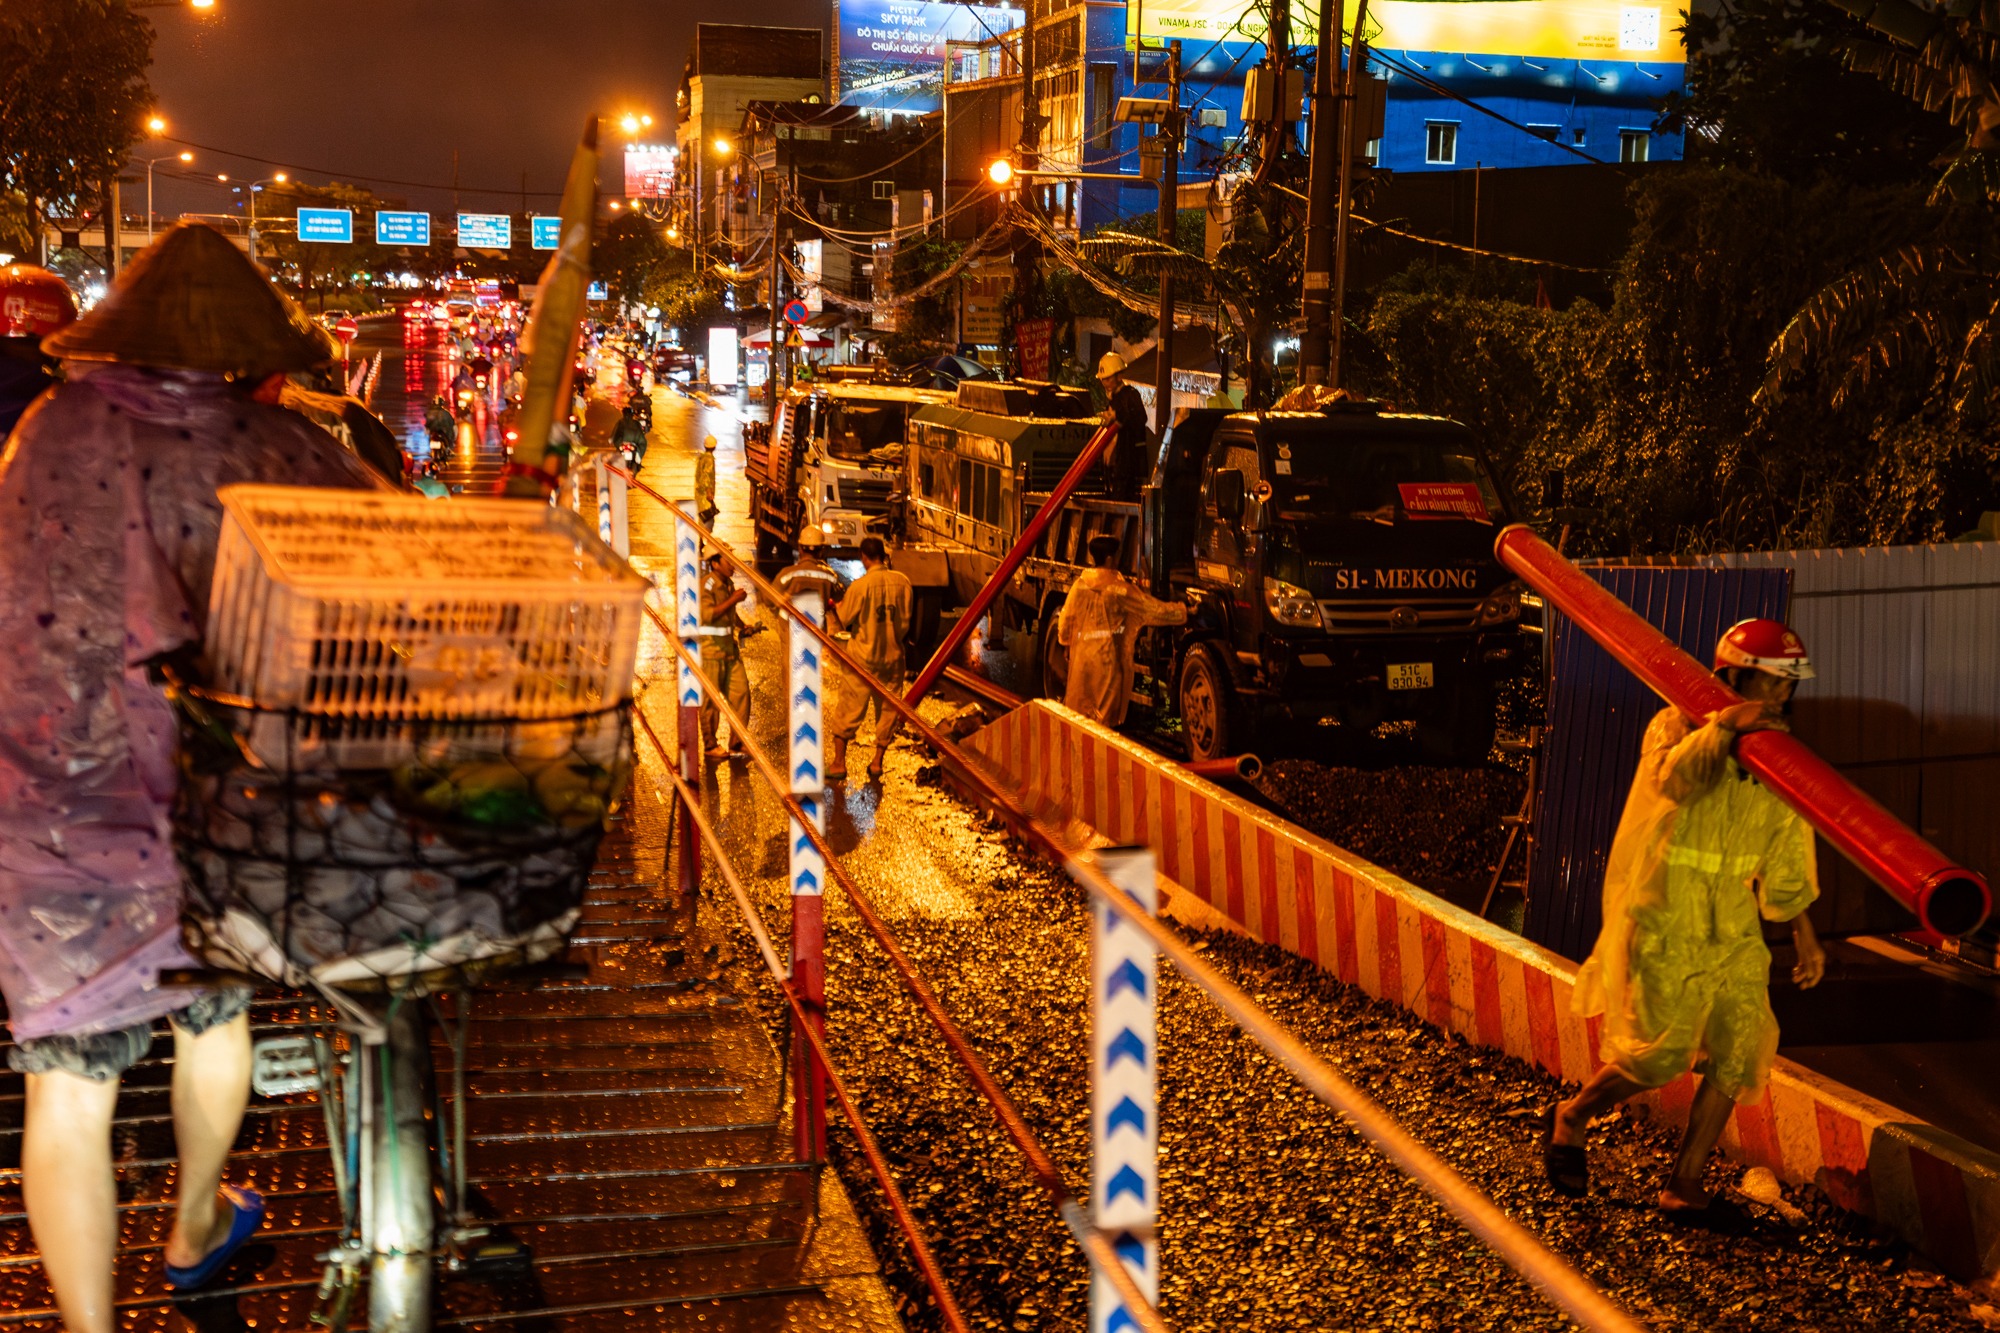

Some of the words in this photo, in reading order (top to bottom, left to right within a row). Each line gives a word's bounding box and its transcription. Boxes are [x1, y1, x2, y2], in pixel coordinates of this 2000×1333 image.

[889, 5, 918, 14] PICITY
[881, 14, 900, 25] SKY
[901, 15, 927, 27] PARK
[1158, 17, 1190, 28] VINAMA
[1193, 19, 1208, 29] JSC
[857, 26, 871, 37] ĐÔ
[872, 29, 886, 41] THỊ
[887, 28, 900, 40] SỐ
[1417, 488, 1428, 496] XE
[1429, 488, 1442, 496] THI
[1442, 486, 1465, 496] CÔNG
[1374, 568, 1477, 590] MEKONG
[1400, 663, 1421, 676] 51C
[1392, 676, 1429, 689] 930.94
